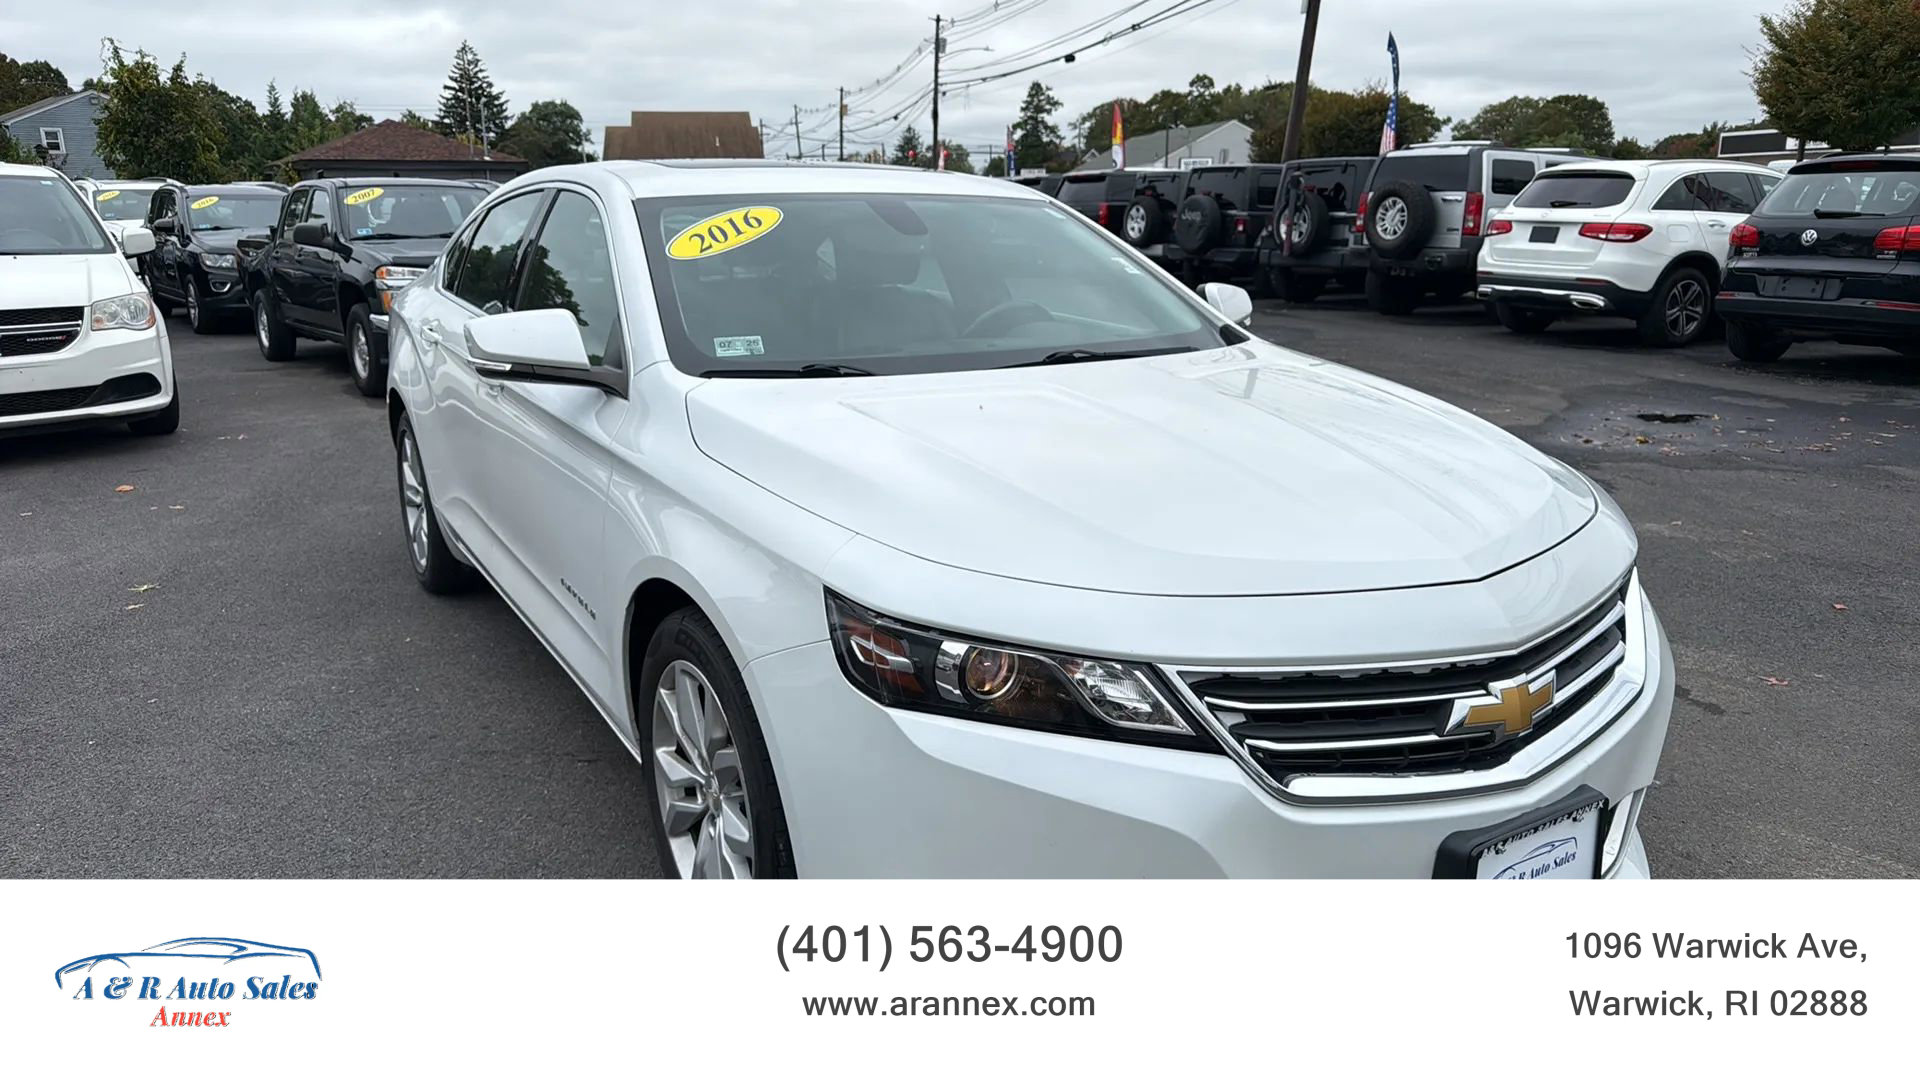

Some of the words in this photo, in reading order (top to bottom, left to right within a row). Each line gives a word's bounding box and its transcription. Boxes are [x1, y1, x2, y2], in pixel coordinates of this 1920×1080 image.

[351, 189, 375, 203] 2007
[689, 209, 762, 253] 2016
[1529, 863, 1551, 879] Auto
[1552, 851, 1577, 870] Sales
